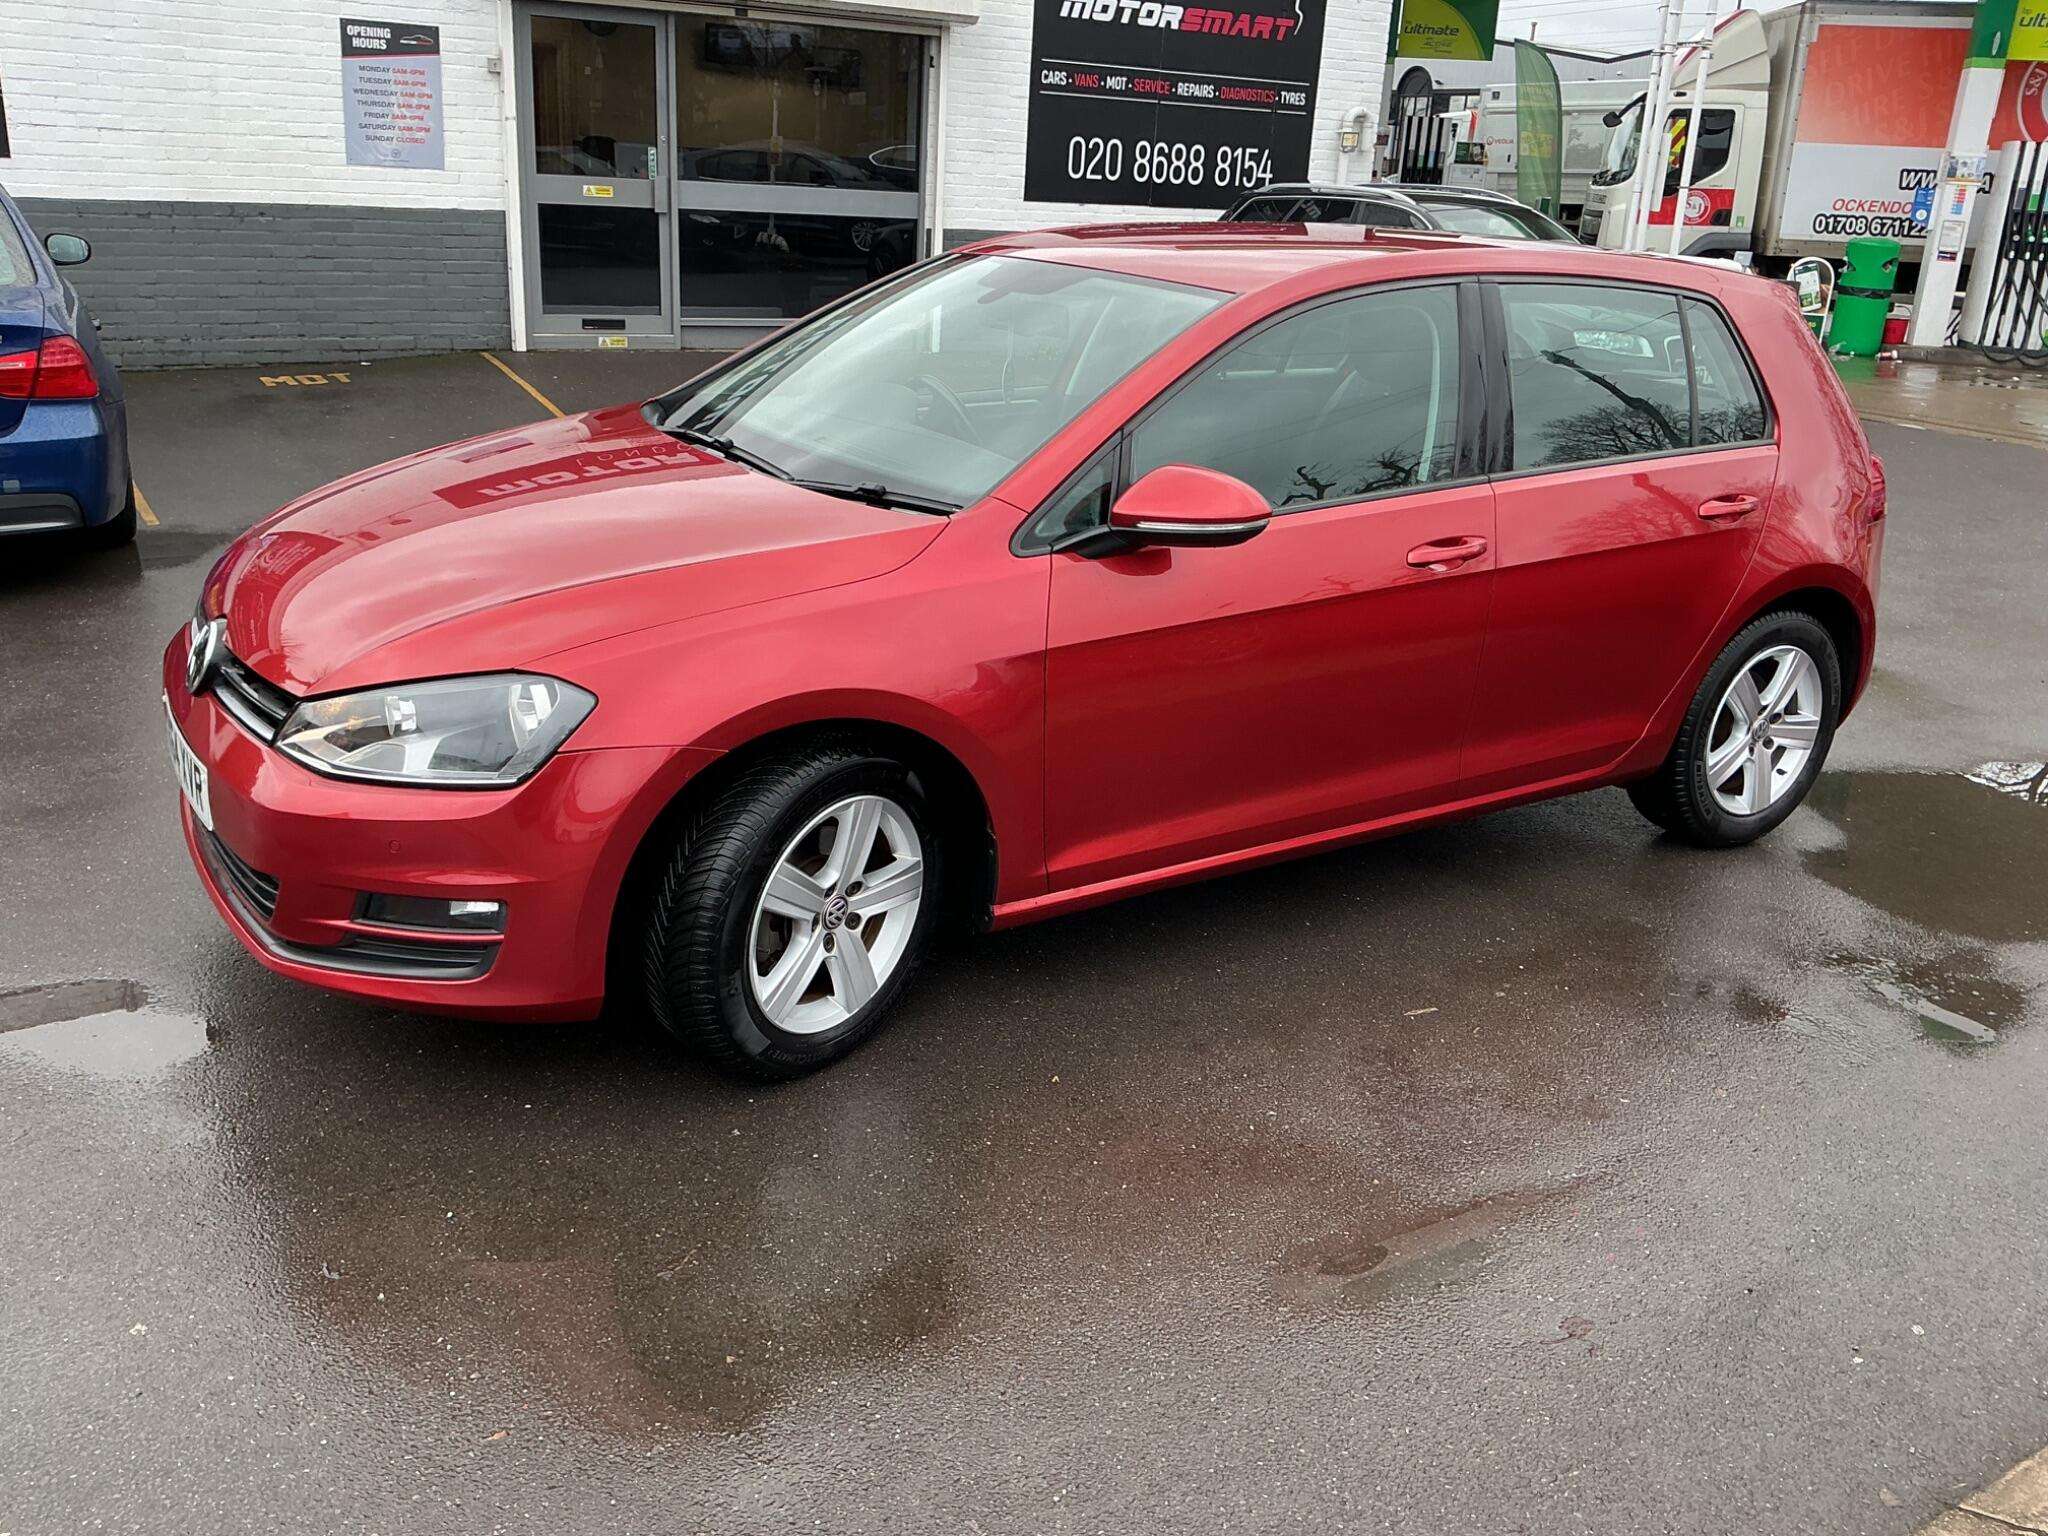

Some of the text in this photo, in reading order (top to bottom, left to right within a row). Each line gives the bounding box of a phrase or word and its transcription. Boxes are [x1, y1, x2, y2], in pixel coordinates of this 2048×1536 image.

[1059, 0, 1296, 41] MOTORSMART
[346, 25, 391, 39] OPENING
[352, 37, 387, 50] HOURS
[358, 65, 391, 74] MONDAY
[358, 77, 392, 85] TUESDAY
[1041, 69, 1306, 106] CARS VANS MOT SERVICE REPAIRS DIAGNOSTICS TYRES
[353, 88, 398, 97] WEDNESDAY
[357, 99, 396, 109] THURSDAY
[358, 123, 396, 132] SATURDAY
[365, 134, 426, 145] SUNDAY CLOSED
[1067, 136, 1273, 188] 020 8688 8154
[1832, 198, 1913, 215] OCKENDO
[1814, 214, 1867, 233] 01708
[259, 372, 351, 387] MOT
